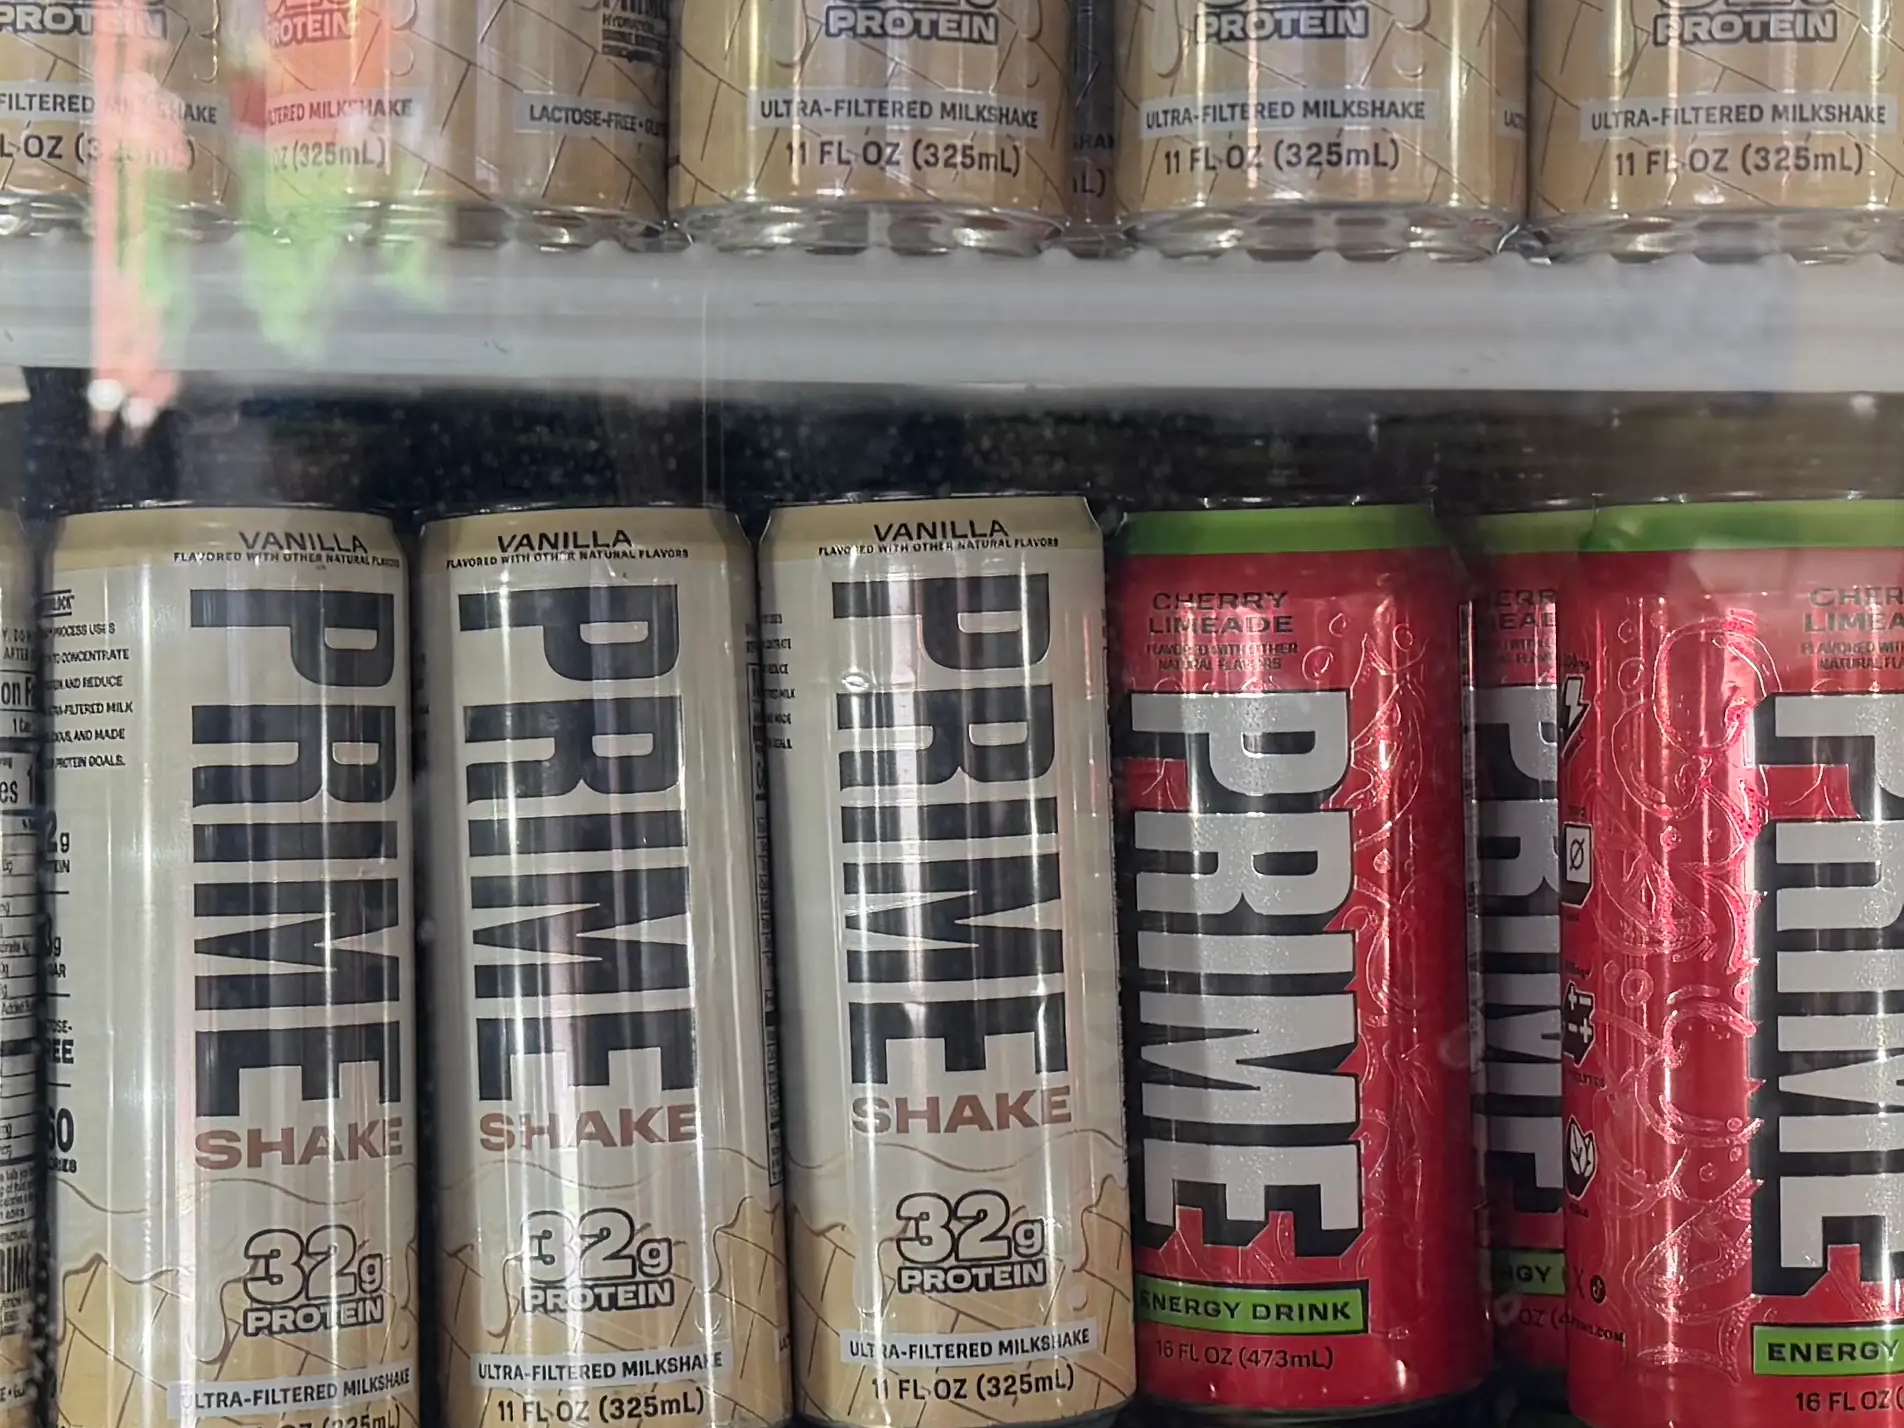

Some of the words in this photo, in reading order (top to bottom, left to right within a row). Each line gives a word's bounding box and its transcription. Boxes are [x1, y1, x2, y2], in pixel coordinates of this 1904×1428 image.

[826, 6, 998, 45] PROTEIN
[1194, 6, 1371, 43] PROTEIN
[528, 104, 638, 133] LACTOSE-FREE
[1590, 103, 1765, 133] ULTRA-FILTERED
[1770, 101, 1887, 126] MILKSHAKE
[1614, 149, 1637, 177] 11
[1645, 149, 1679, 176] FL
[1687, 147, 1730, 174] OZ
[1739, 139, 1865, 178] (325mL)
[238, 530, 369, 554] VANILLA
[497, 529, 633, 553] VANILLA
[873, 519, 1010, 542] VANILLA
[446, 555, 498, 570] FLAVORED
[501, 552, 530, 566] WITH
[534, 551, 575, 564] OTHER
[579, 549, 636, 562] NATURAL
[638, 547, 690, 561] FLAVORS
[458, 584, 696, 1101] PRIME
[832, 573, 1070, 1085] PRIME
[190, 589, 401, 1117] PRIME
[1129, 689, 1363, 1254] PRIME
[479, 1103, 699, 1153] SHAKE
[850, 1085, 1073, 1137] SHAKE
[194, 1118, 404, 1170] SHAKE
[519, 1207, 674, 1282] 32g
[896, 1188, 1046, 1264] 32g
[243, 1223, 383, 1307] 32g
[897, 1259, 1047, 1295] PROTEIN
[520, 1278, 674, 1314] PROTEIN
[1250, 1297, 1352, 1323] DRINK
[242, 1294, 383, 1339] PROTEIN
[477, 1360, 618, 1384] ULTRA-FILTERED
[621, 1349, 723, 1376] MILKSHAKE
